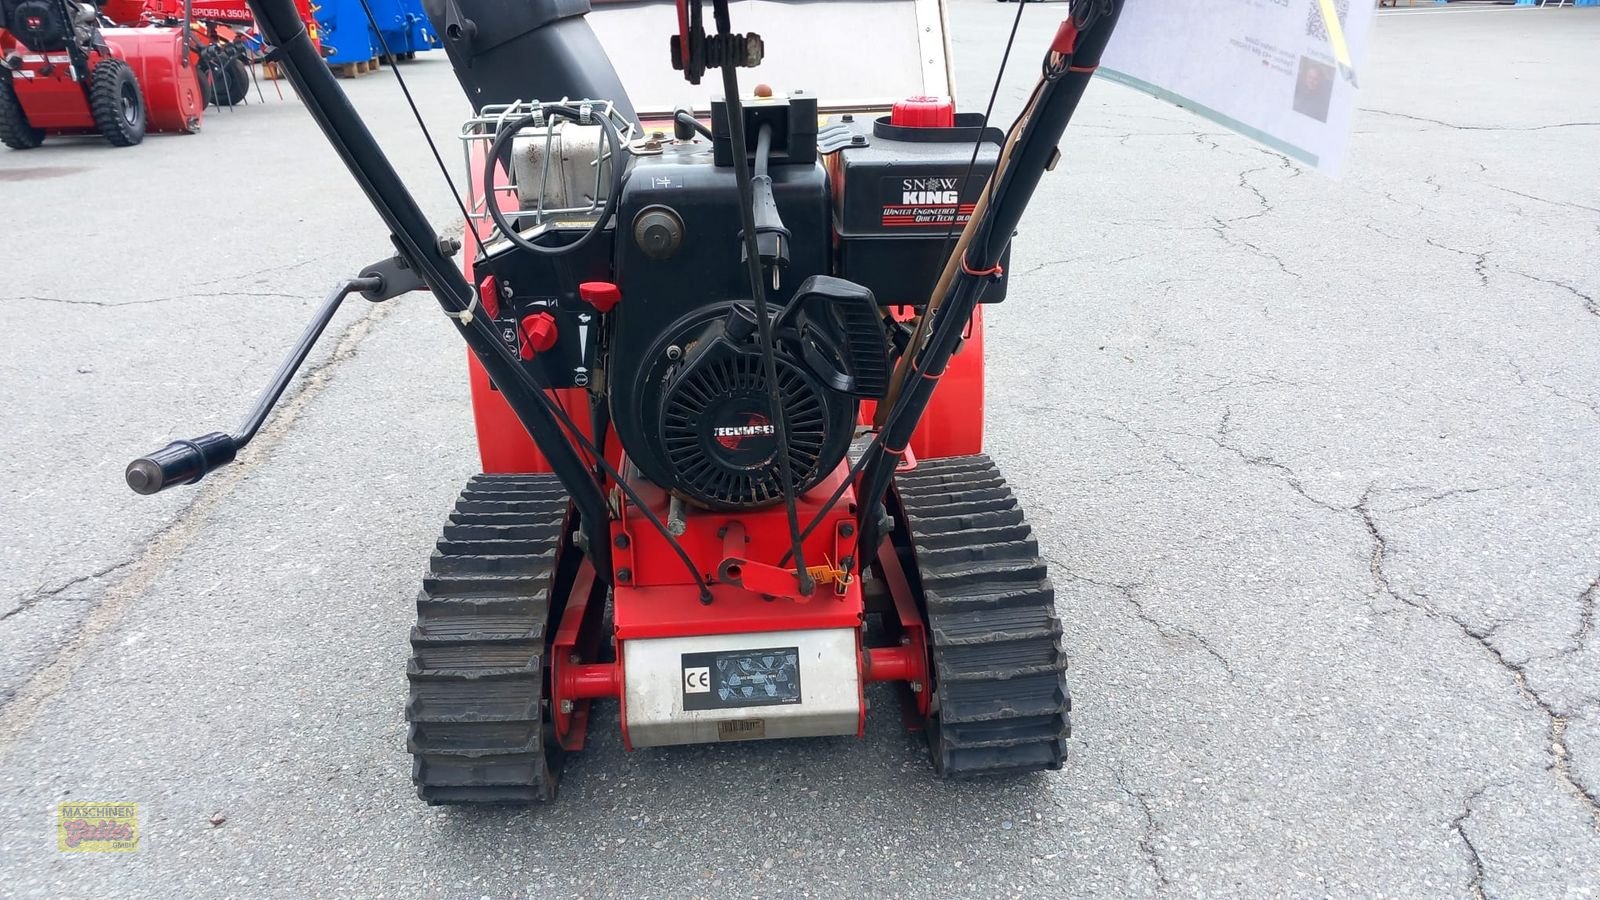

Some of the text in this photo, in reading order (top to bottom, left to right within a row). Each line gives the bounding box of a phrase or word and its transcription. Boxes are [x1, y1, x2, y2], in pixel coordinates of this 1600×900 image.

[192, 8, 219, 17] SPIDER
[903, 178, 958, 190] SNOW
[902, 190, 958, 204] KING
[912, 207, 956, 215] ENGINEERED
